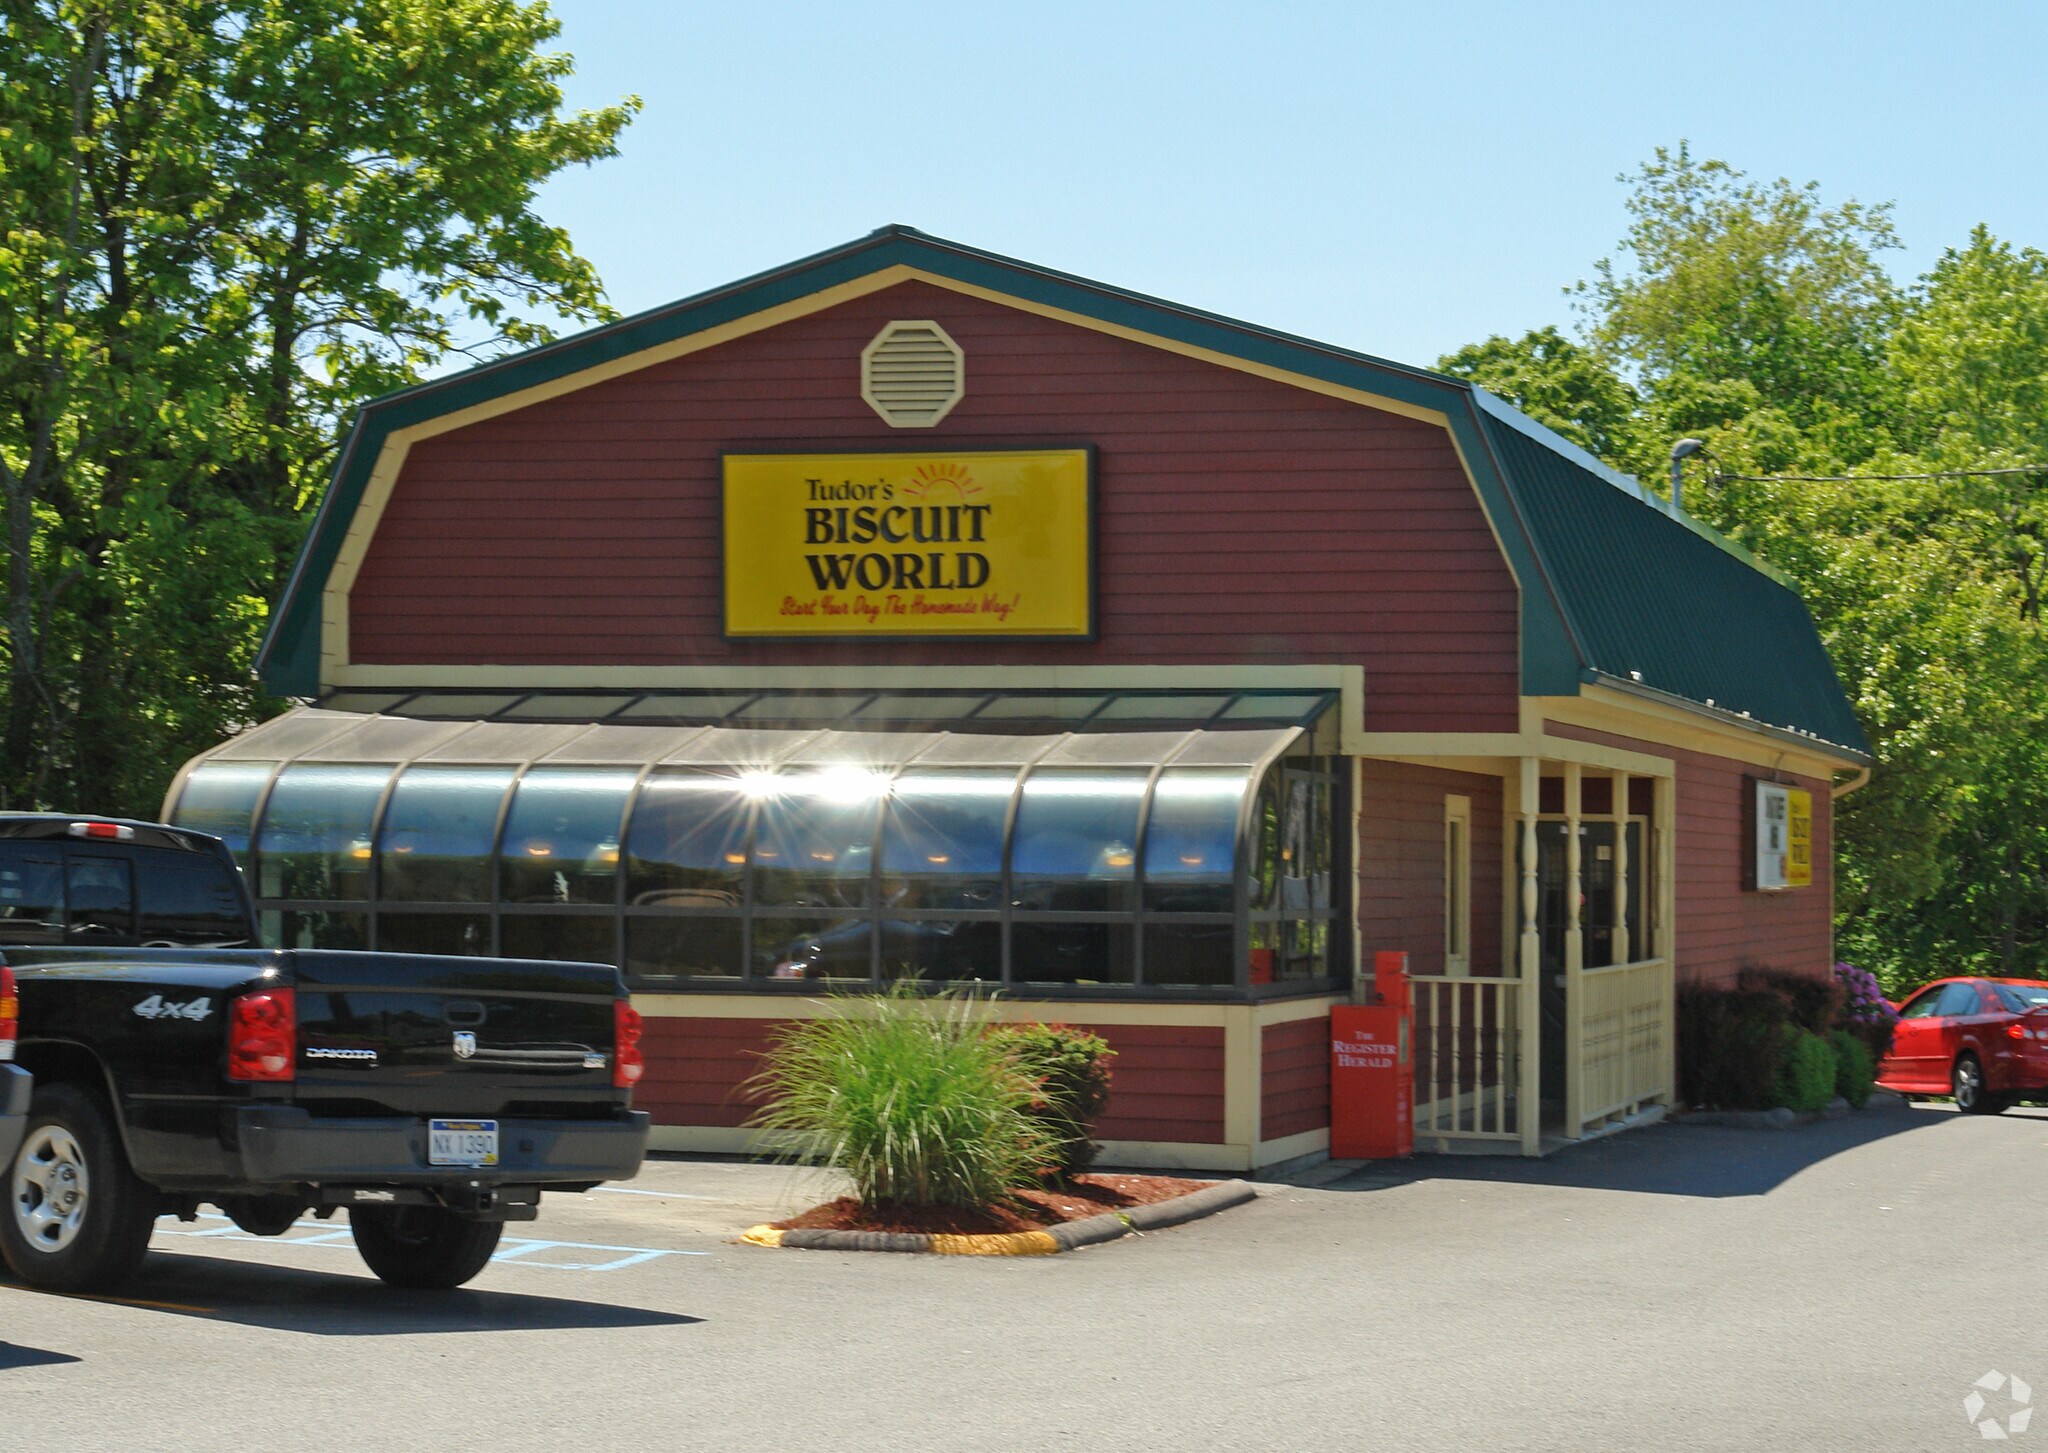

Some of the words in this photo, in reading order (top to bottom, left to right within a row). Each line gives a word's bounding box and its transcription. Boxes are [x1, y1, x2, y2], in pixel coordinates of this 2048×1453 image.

[805, 478, 894, 501] Tudor's
[805, 504, 992, 544] BISCUIT
[805, 552, 990, 591] WORLD
[780, 595, 818, 616] Start
[820, 595, 849, 615] Your
[853, 595, 880, 624] Day
[884, 594, 906, 615] The
[910, 594, 978, 615] Homemade
[981, 592, 1020, 623] Way!
[133, 994, 213, 1022] 4x4
[306, 1047, 378, 1060] DAKOTA
